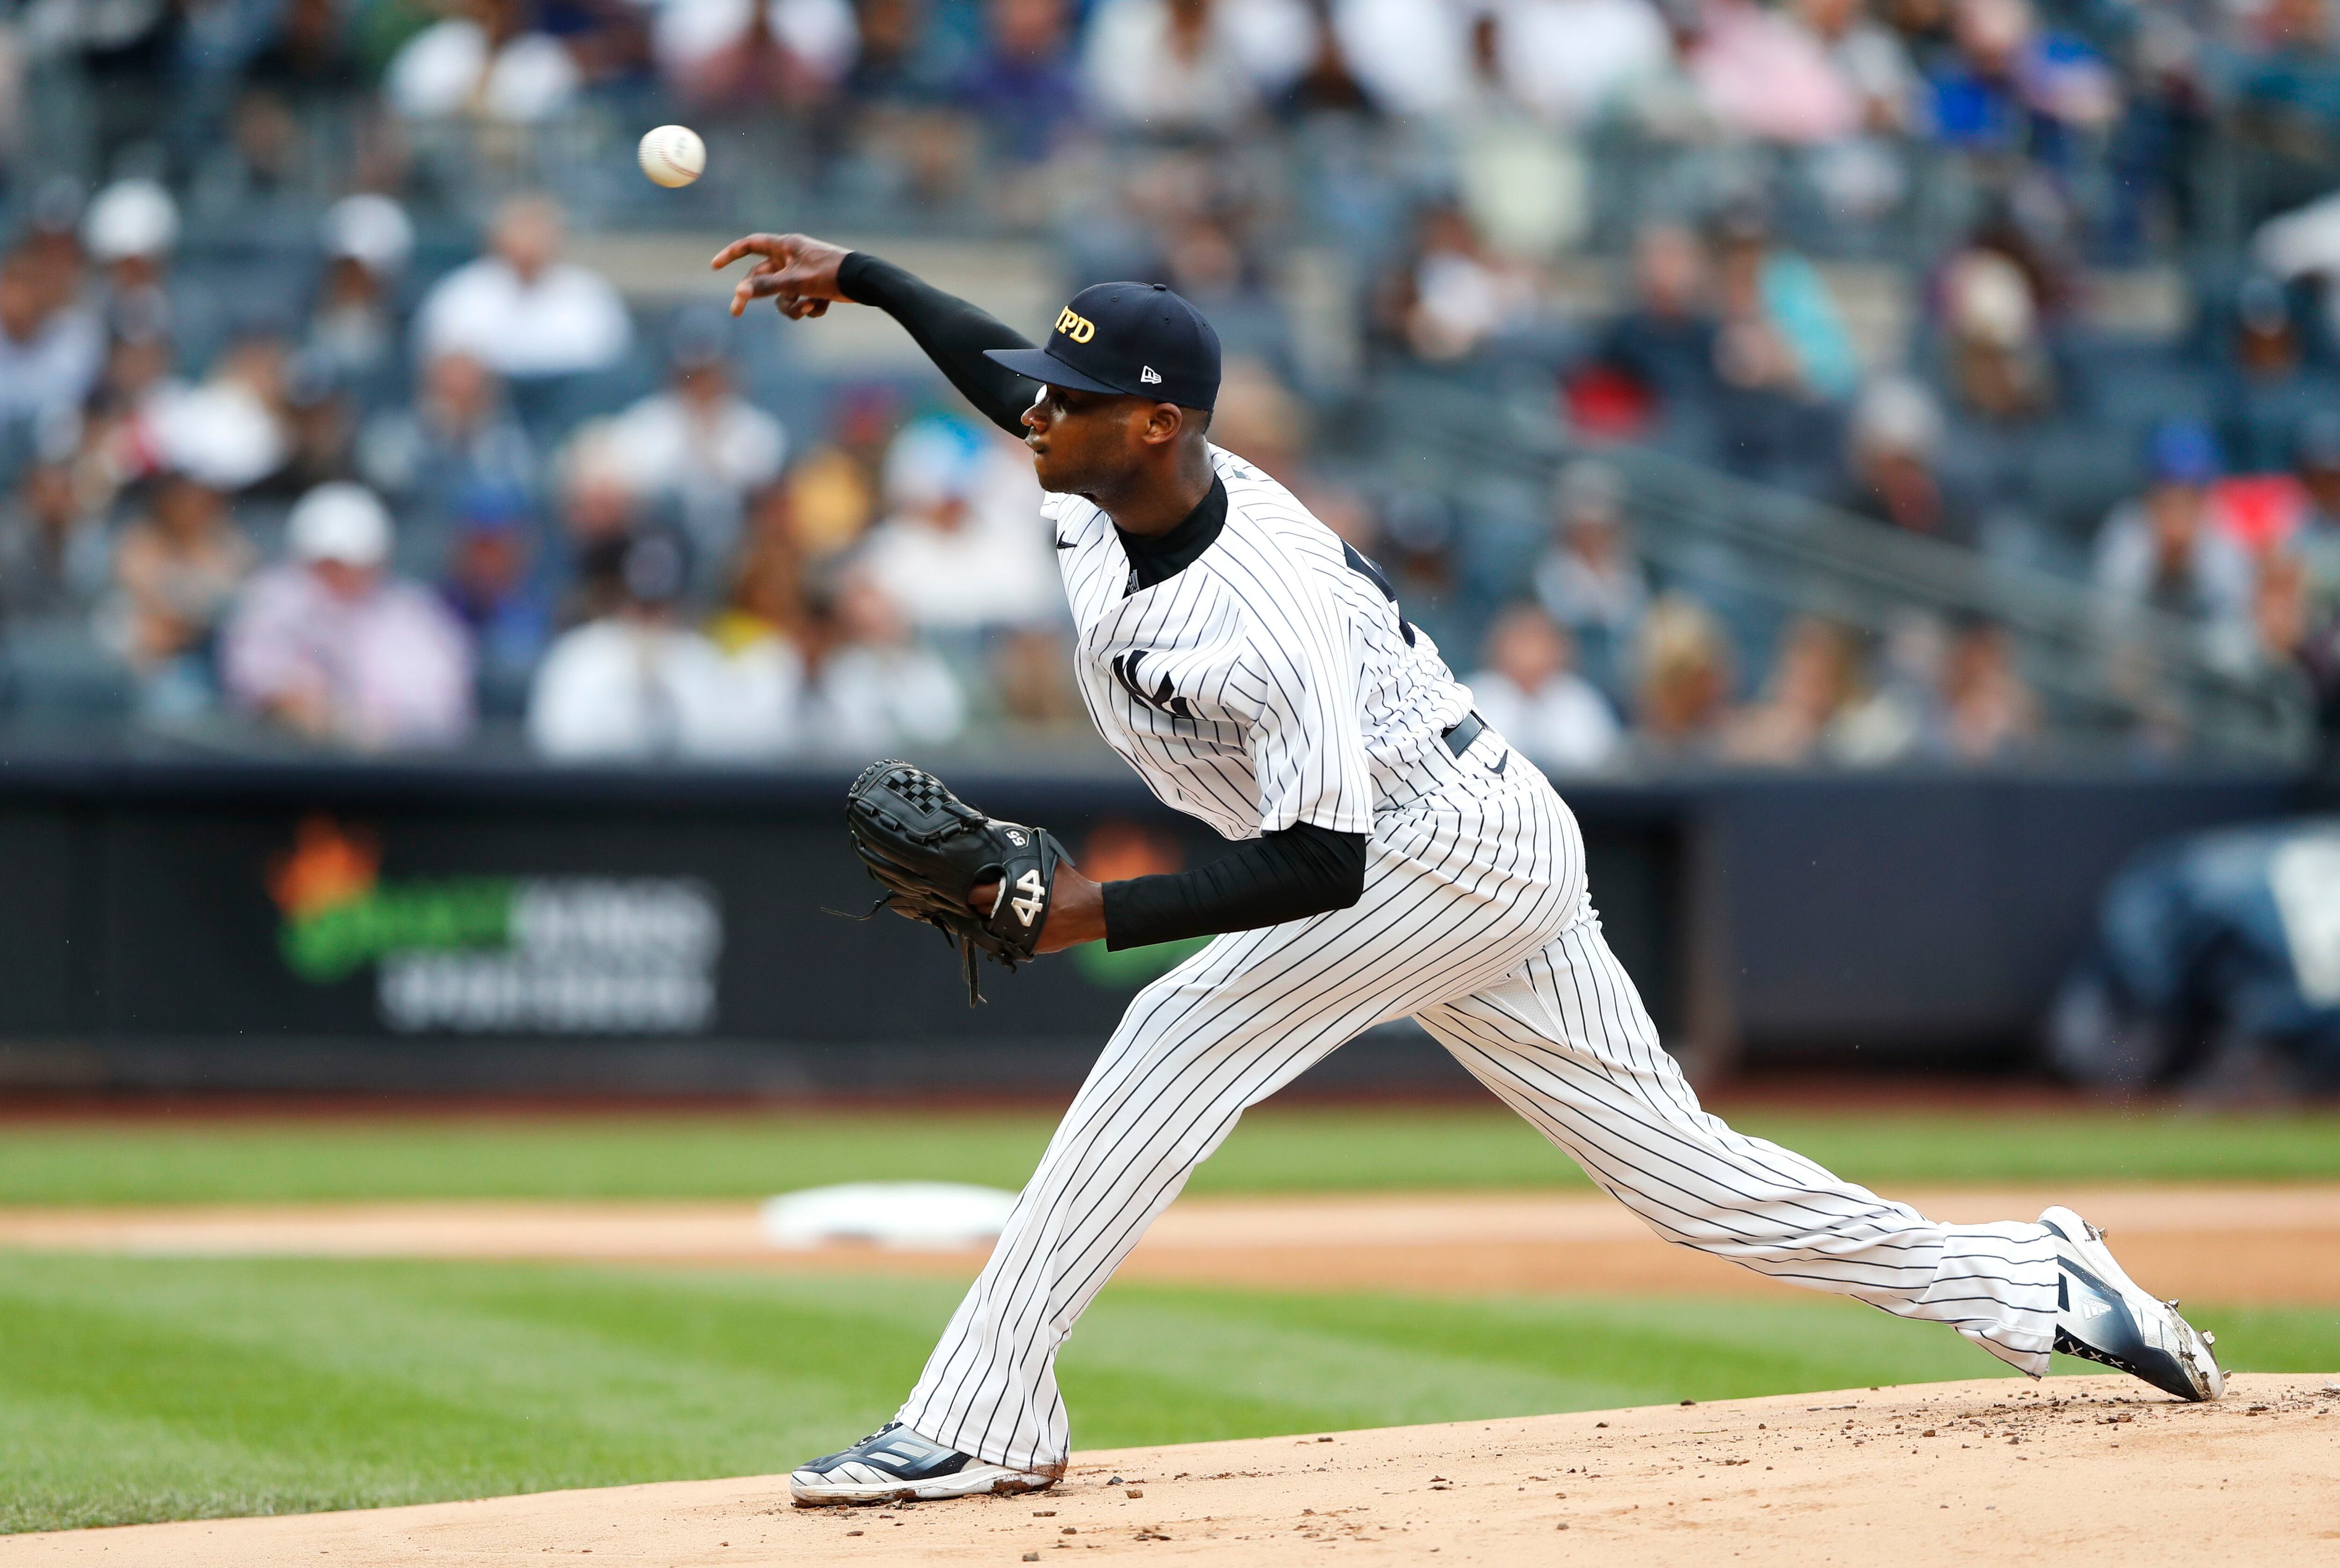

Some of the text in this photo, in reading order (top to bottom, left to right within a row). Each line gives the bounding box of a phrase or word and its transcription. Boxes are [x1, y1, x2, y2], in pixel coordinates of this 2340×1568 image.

[1006, 831, 1025, 846] 55
[1011, 869, 1045, 927] 44
[2078, 1295, 2111, 1310] adidas
